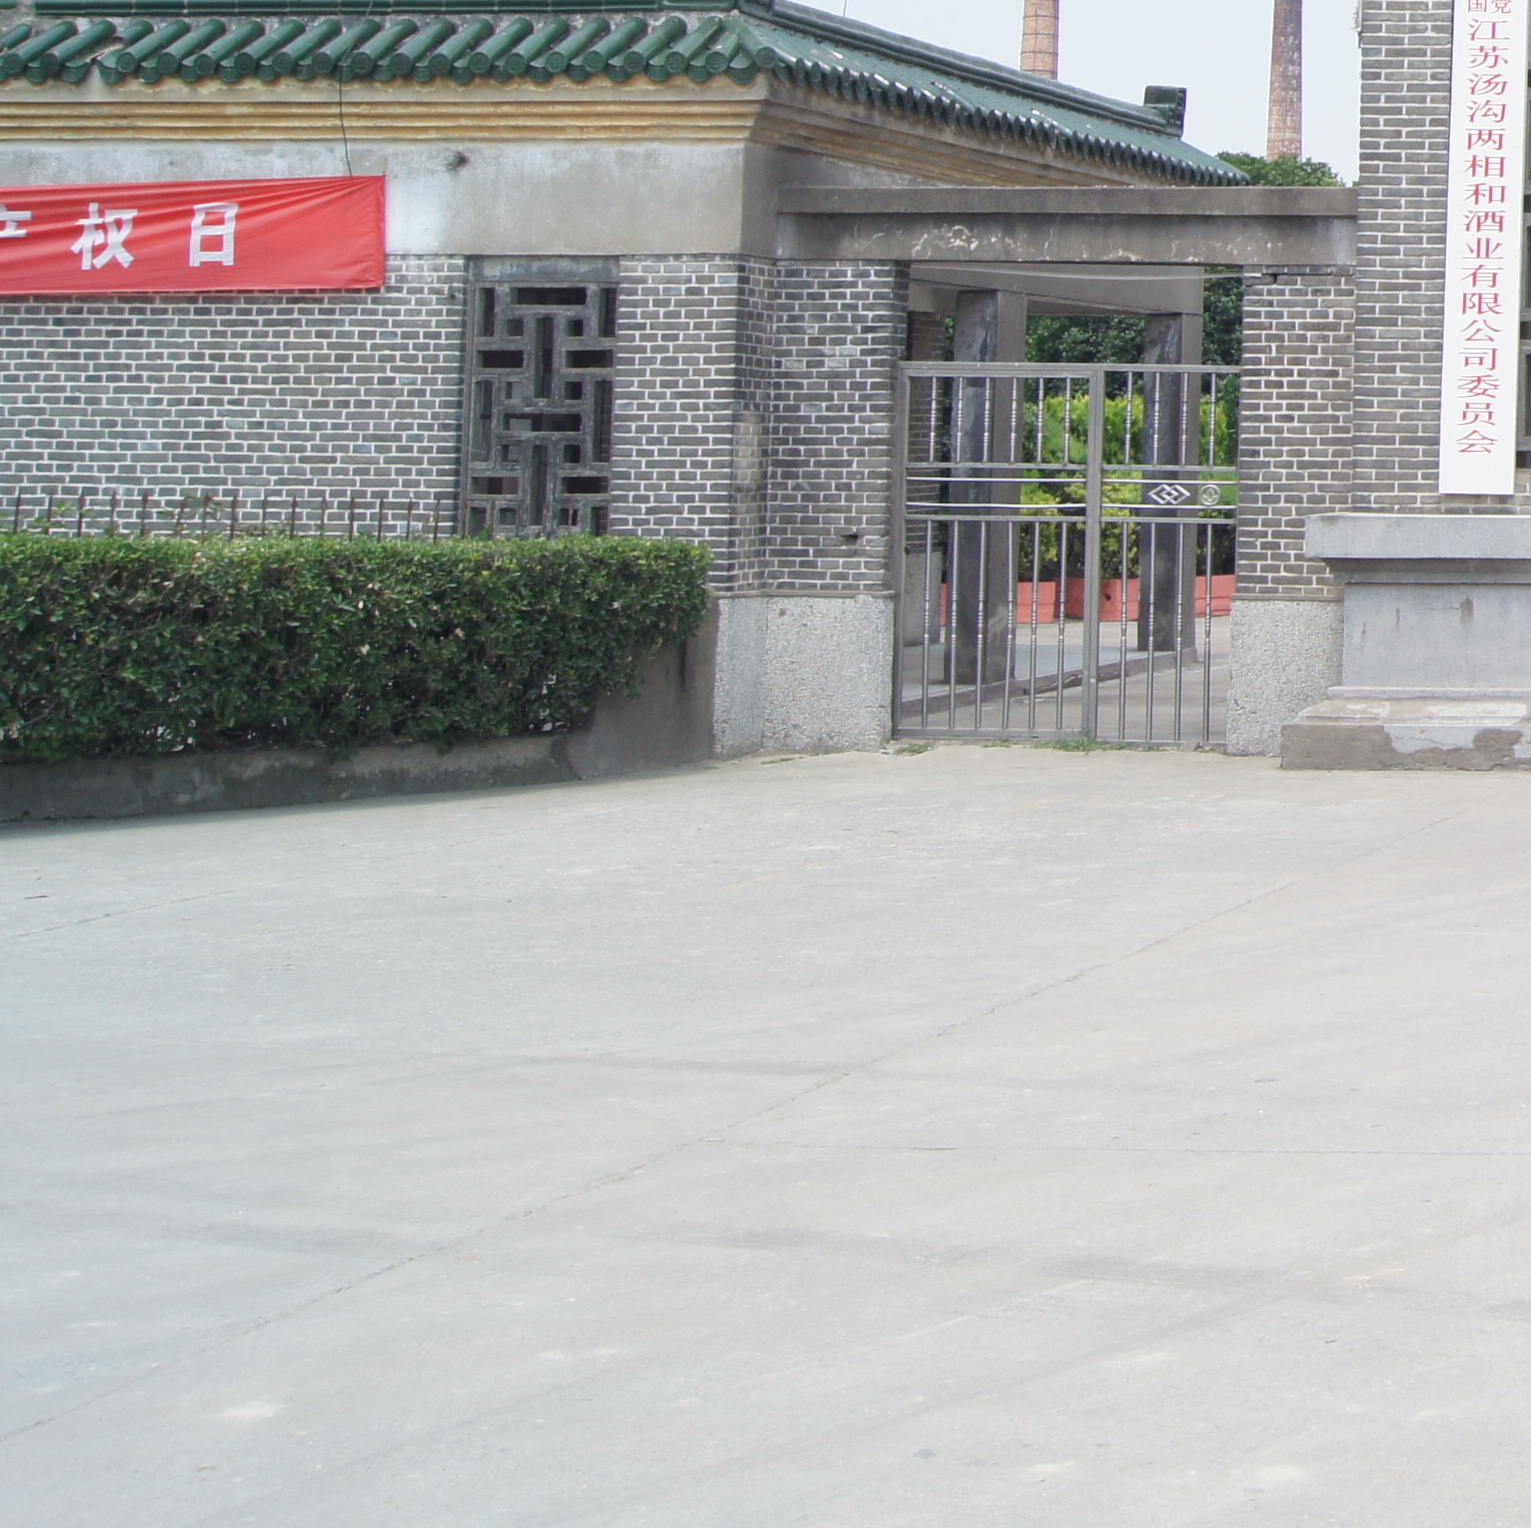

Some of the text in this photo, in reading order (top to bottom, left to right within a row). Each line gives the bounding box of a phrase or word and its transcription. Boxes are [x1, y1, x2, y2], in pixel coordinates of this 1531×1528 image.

[1456, 18, 1511, 454] 江苏汤沟两相和酒业有限公司委员会
